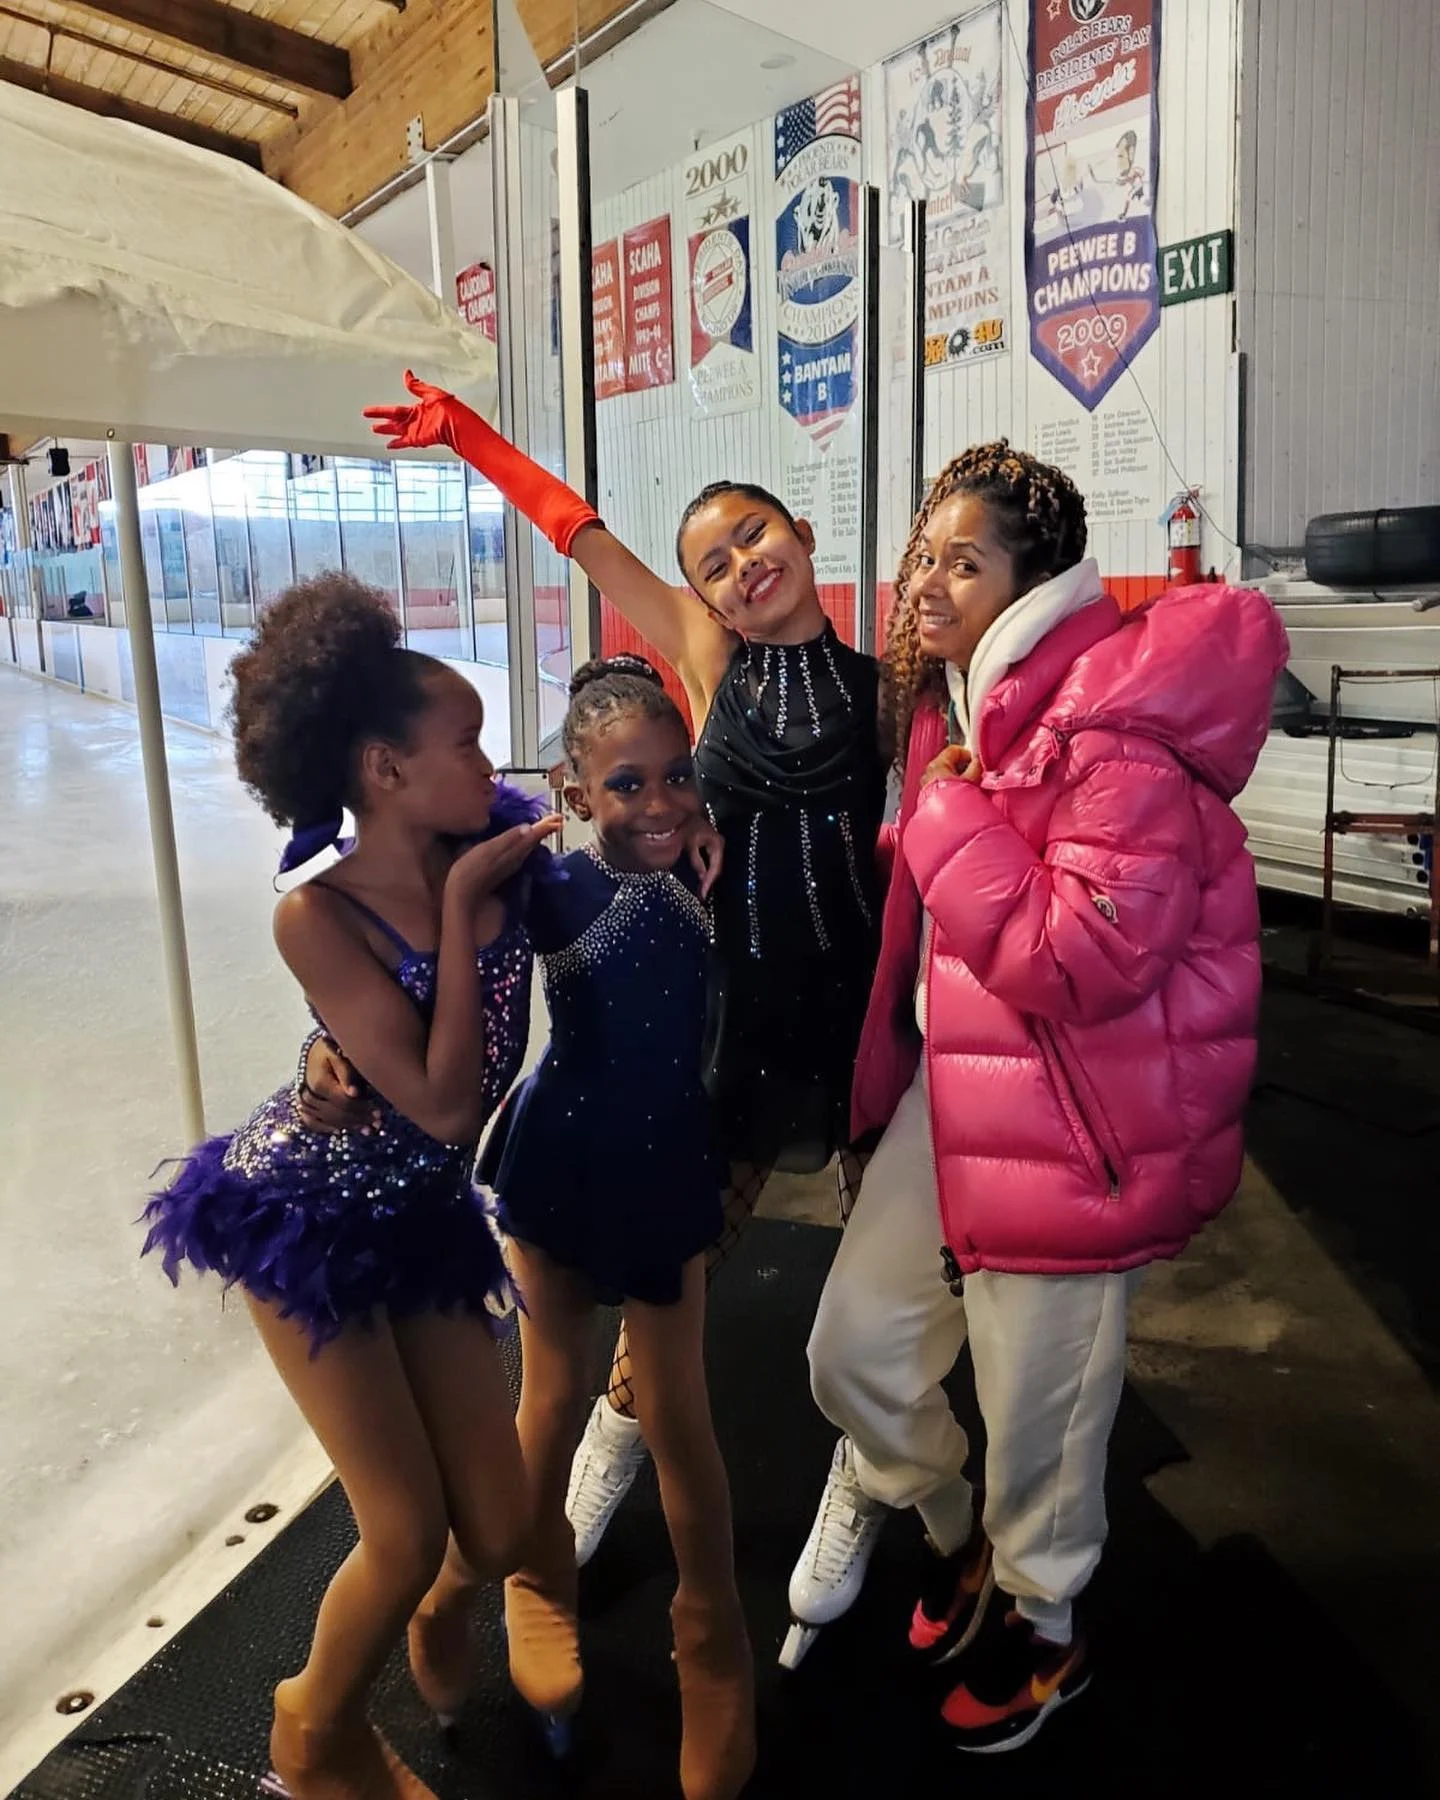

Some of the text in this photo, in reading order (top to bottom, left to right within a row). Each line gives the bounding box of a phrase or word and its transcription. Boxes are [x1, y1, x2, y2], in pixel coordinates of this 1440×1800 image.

[1051, 16, 1132, 64] POLAR BEARS
[1121, 25, 1152, 54] DAY
[685, 144, 748, 196] 2000
[630, 240, 662, 276] SCAHA
[1047, 231, 1136, 277] PEEWEE B
[1163, 238, 1222, 296] EXIT
[978, 265, 989, 283] A
[1034, 263, 1152, 315] CHAMPIONS
[809, 319, 837, 341] 2010
[1057, 314, 1128, 352] 2009
[629, 350, 652, 376] MITE
[795, 352, 851, 384] BANTAM
[818, 380, 828, 401] B
